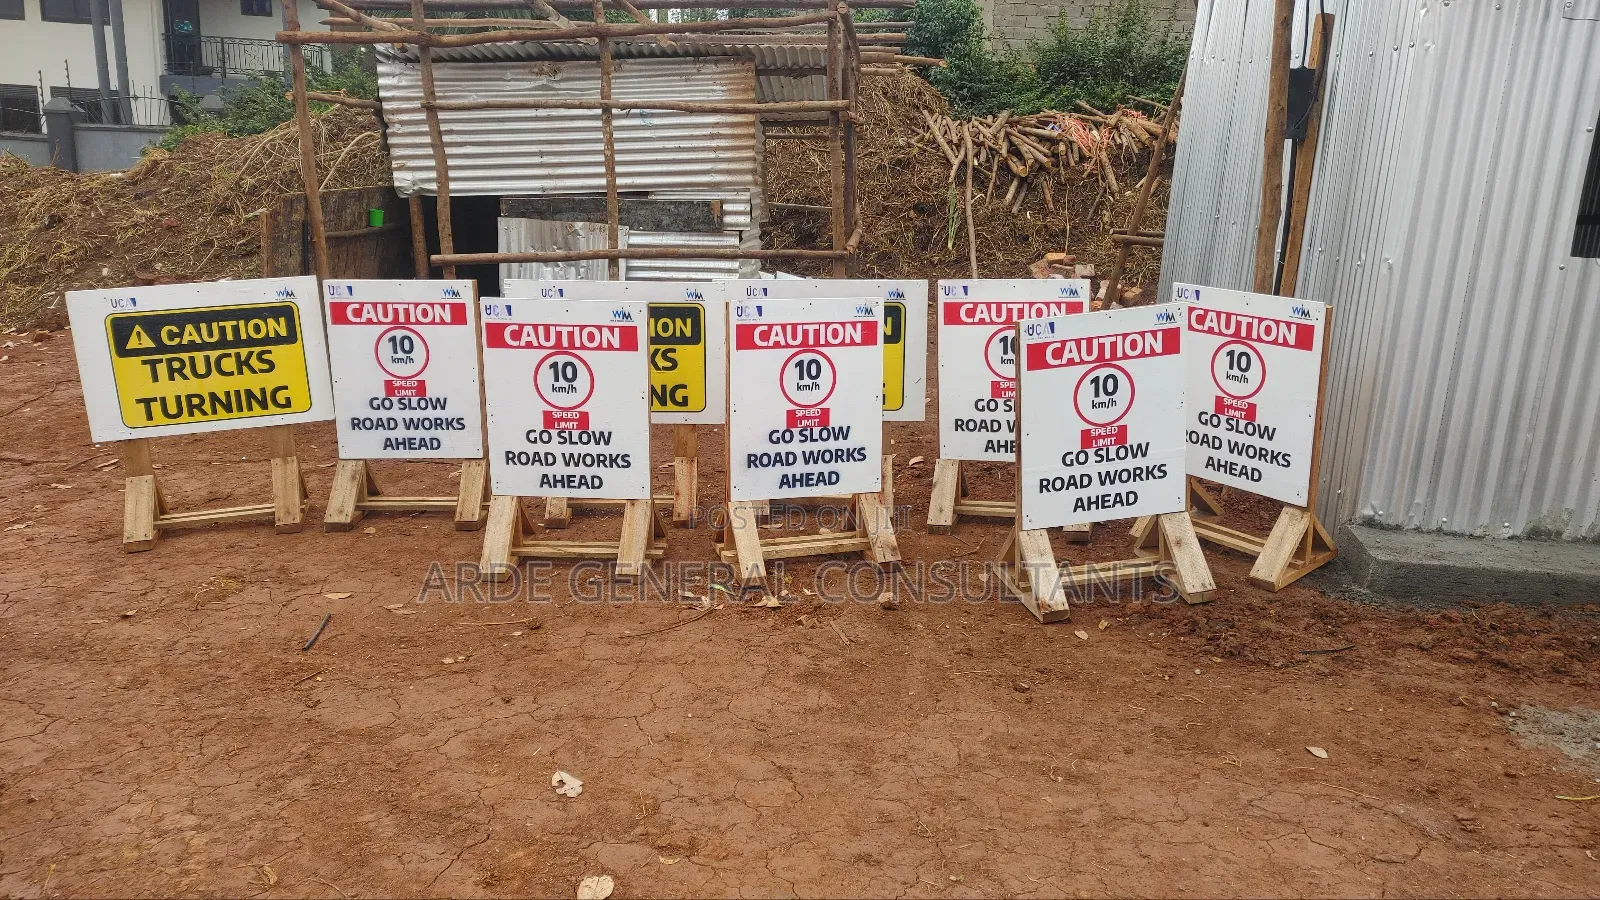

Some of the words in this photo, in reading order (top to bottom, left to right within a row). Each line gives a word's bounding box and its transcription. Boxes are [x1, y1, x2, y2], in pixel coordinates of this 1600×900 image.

[346, 303, 451, 323] CAUTION
[959, 303, 1066, 322] CAUTION
[160, 316, 289, 346] CAUTION
[753, 323, 862, 347] CAUTION
[1190, 309, 1297, 346] CAUTION
[387, 335, 415, 355] 10
[503, 325, 621, 349] CAUTION
[1045, 331, 1163, 365] CAUTION
[141, 349, 276, 383] TRUCKS
[391, 356, 415, 365] km/h
[794, 358, 822, 381] 10
[1225, 350, 1252, 373] 10
[549, 361, 578, 383] 10
[1226, 371, 1249, 384] km/h
[551, 384, 577, 394] km/h
[796, 382, 820, 391] km/h
[1089, 373, 1119, 398] 10
[135, 385, 292, 422] TURNING
[369, 397, 393, 411] GO
[397, 397, 448, 411] SLOW
[974, 398, 999, 412] GO
[1092, 398, 1117, 410] km/h
[1223, 397, 1248, 409] SPEED
[551, 411, 580, 420] SPEED
[795, 409, 821, 417] SPEED
[1224, 407, 1247, 419] LIMIT
[351, 417, 398, 431] ROAD
[402, 417, 466, 431] WORKS
[554, 421, 579, 430] LIMIT
[797, 418, 820, 427] LIMIT
[954, 418, 1002, 433] ROAD
[1090, 426, 1118, 437] SPEED
[1198, 411, 1222, 429] GO
[1225, 417, 1277, 442] SLOW
[383, 437, 441, 451] AHEAD
[525, 429, 552, 445] GO
[556, 429, 612, 446] SLOW
[768, 429, 794, 444] GO
[798, 426, 851, 443] SLOW
[1092, 437, 1117, 448] LIMIT
[984, 439, 1016, 454] AHE
[1061, 450, 1089, 467] GO
[1094, 442, 1150, 464] SLOW
[1227, 438, 1291, 468] WORKS
[505, 451, 557, 467] ROAD
[562, 452, 632, 469] WORKS
[747, 451, 797, 468] ROAD
[802, 447, 867, 465] WORKS
[1205, 455, 1263, 483] AHEAD
[539, 474, 604, 490] AHEAD
[778, 471, 840, 489] AHEAD
[1039, 473, 1093, 494] ROAD
[1097, 463, 1168, 487] WORKS
[1072, 491, 1138, 513] AHEAD
